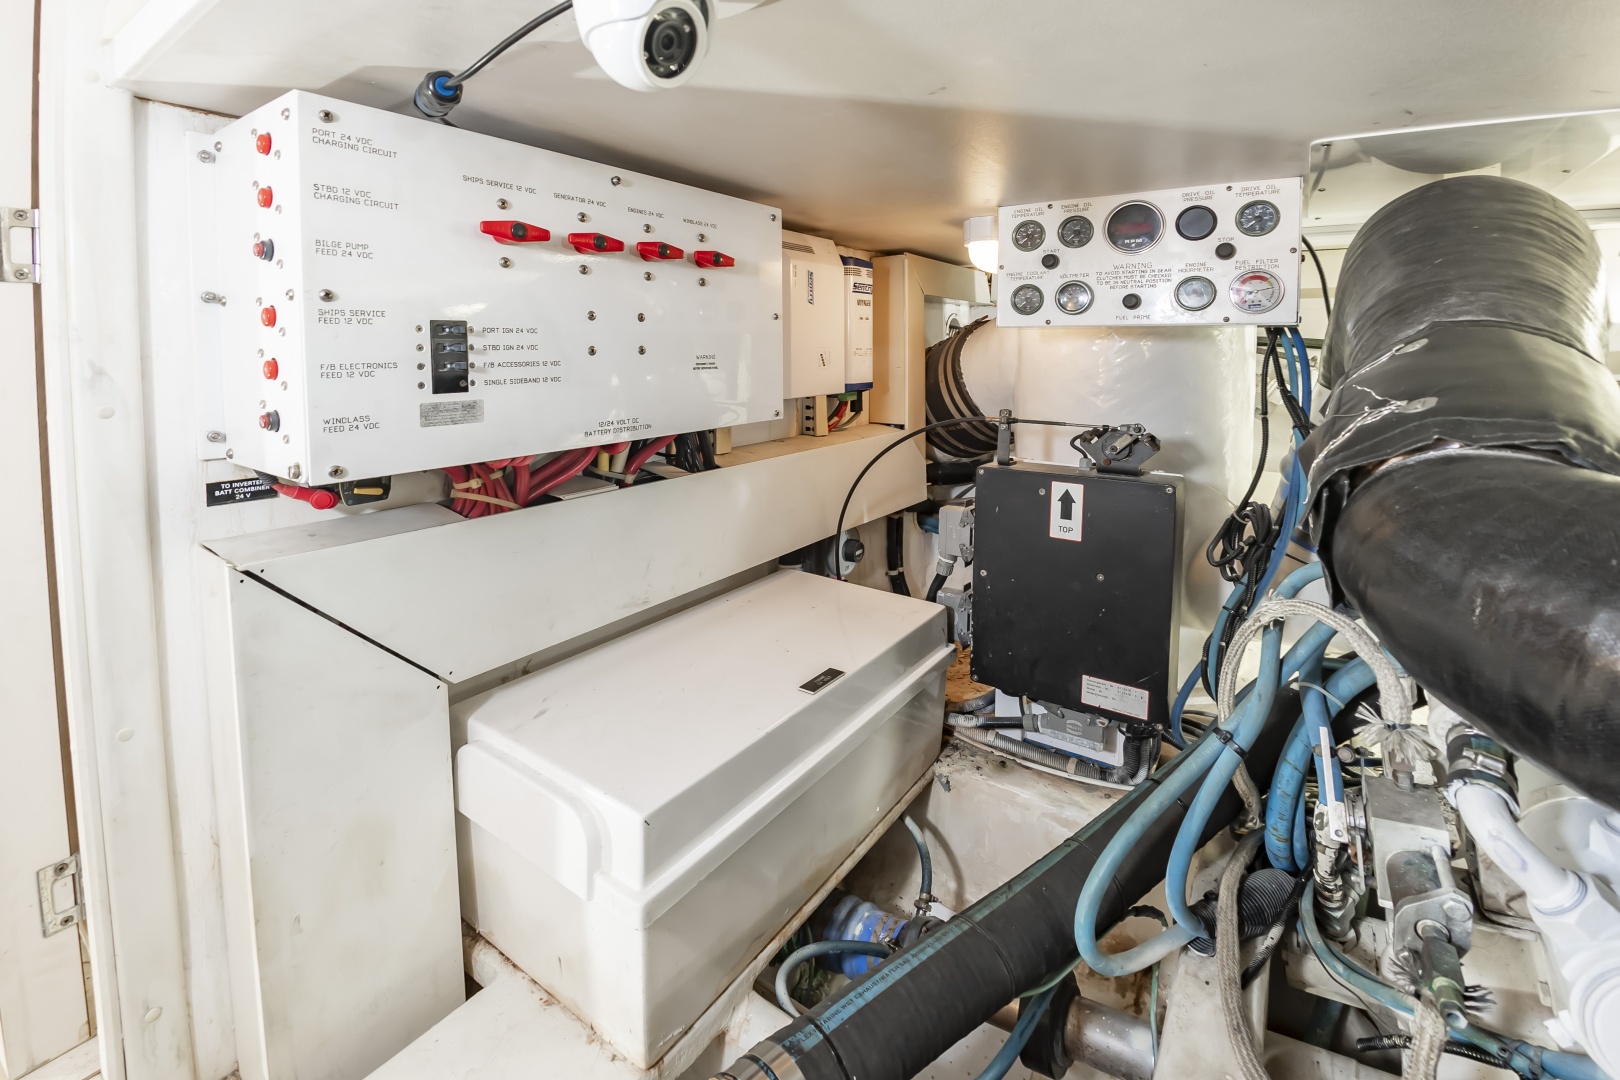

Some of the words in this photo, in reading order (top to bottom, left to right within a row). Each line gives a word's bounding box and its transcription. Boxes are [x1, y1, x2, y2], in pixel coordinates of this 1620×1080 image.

[312, 127, 336, 138] PORT
[356, 137, 373, 146] VDC
[312, 136, 359, 151] CHARGING
[363, 146, 397, 158] CIRCUIT
[463, 175, 484, 185] SHIPS
[486, 179, 513, 190] SERVICE
[313, 184, 338, 194] STBD
[354, 190, 372, 198] VDC
[1235, 189, 1281, 198] TEMPERATURE
[313, 192, 360, 205] CHARGING
[364, 199, 399, 210] CIRCUIT
[554, 193, 586, 203] GENERATOR
[316, 239, 342, 248] BILGE
[346, 242, 369, 250] PUMP
[316, 248, 338, 256] FEED
[1113, 262, 1153, 270] WARNING
[320, 363, 336, 371] F/B
[340, 362, 398, 371] ELECTRONICS
[323, 415, 371, 425] WINDLASS
[598, 420, 614, 428] 12/24
[323, 425, 345, 433] FEED
[348, 424, 359, 432] 24
[363, 422, 380, 430] VDC
[584, 429, 612, 438] BATTERY
[613, 424, 652, 434] DISTRIBUTION
[214, 489, 232, 497] BATT
[1058, 525, 1074, 533] TOP
[840, 999, 855, 1010] WET
